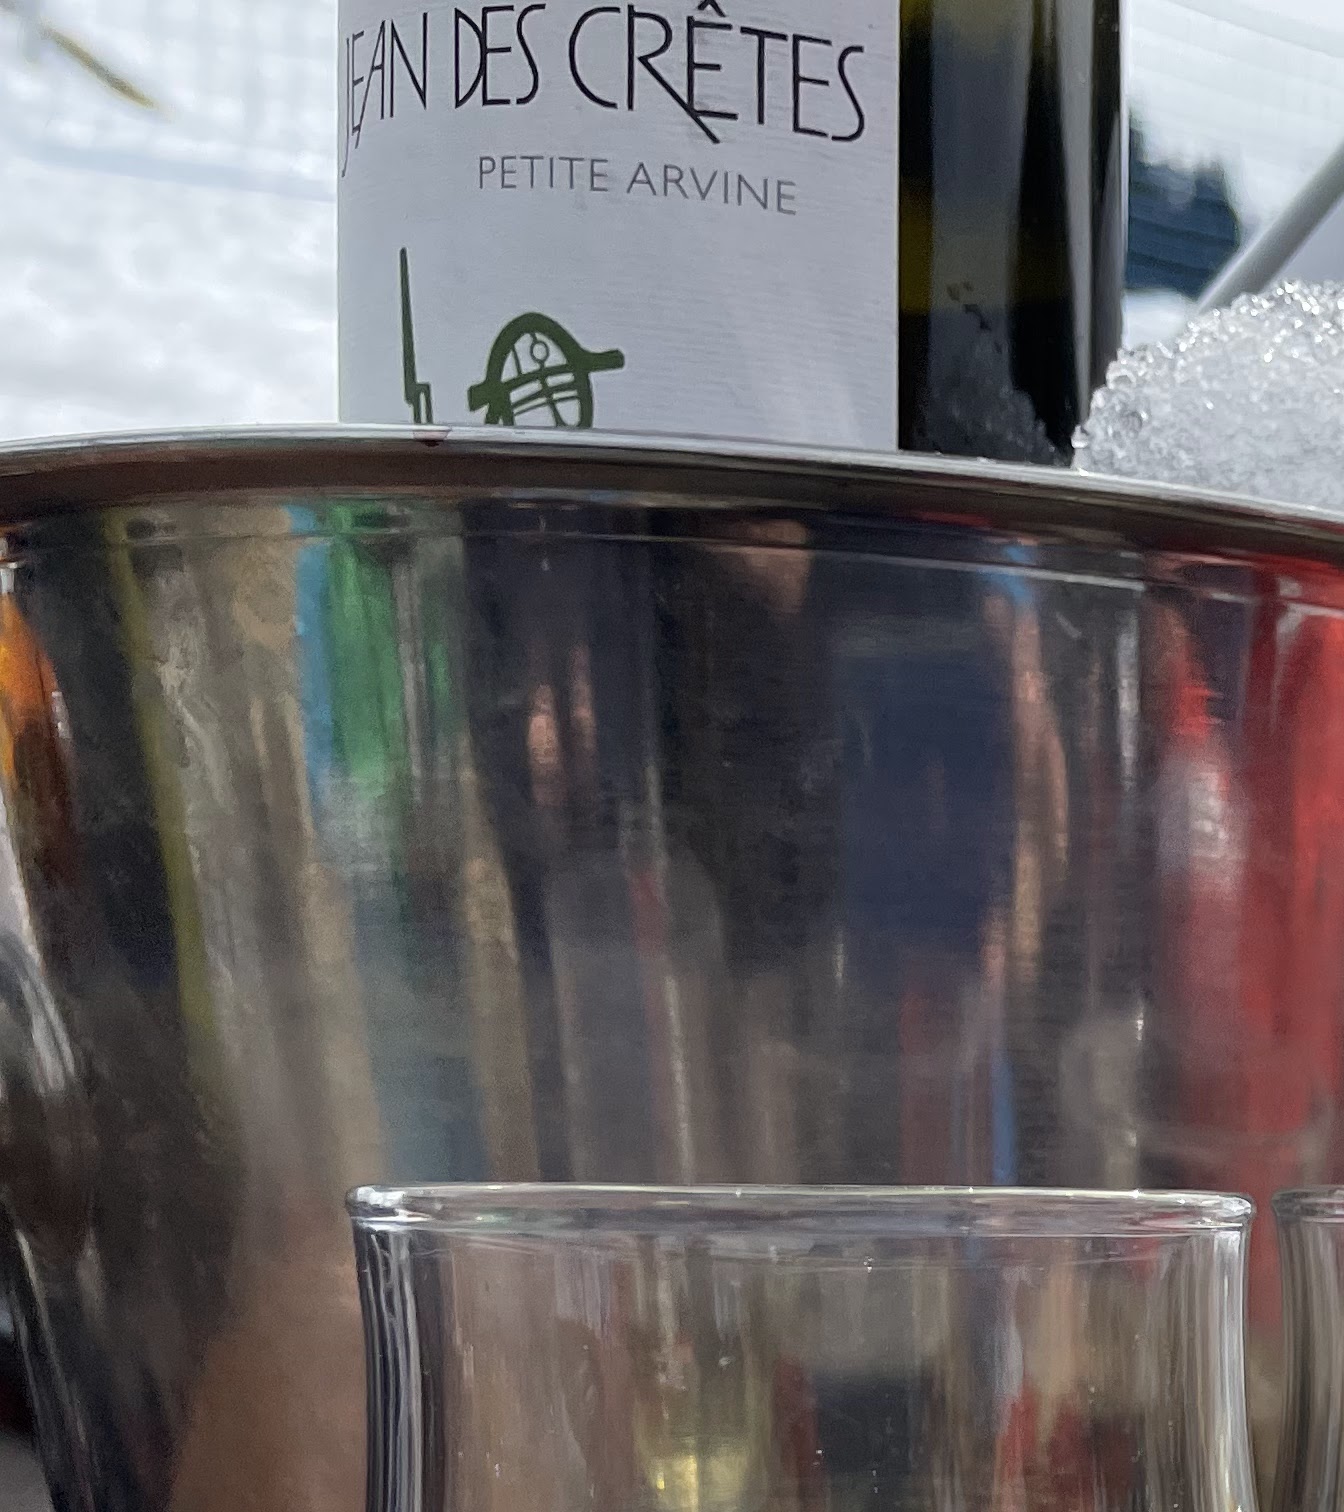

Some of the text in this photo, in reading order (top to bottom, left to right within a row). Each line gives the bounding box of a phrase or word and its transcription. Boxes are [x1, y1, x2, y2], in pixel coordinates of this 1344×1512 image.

[341, 0, 865, 178] JEAN DES CRÊTES
[479, 155, 797, 216] PETITE ARVINE
